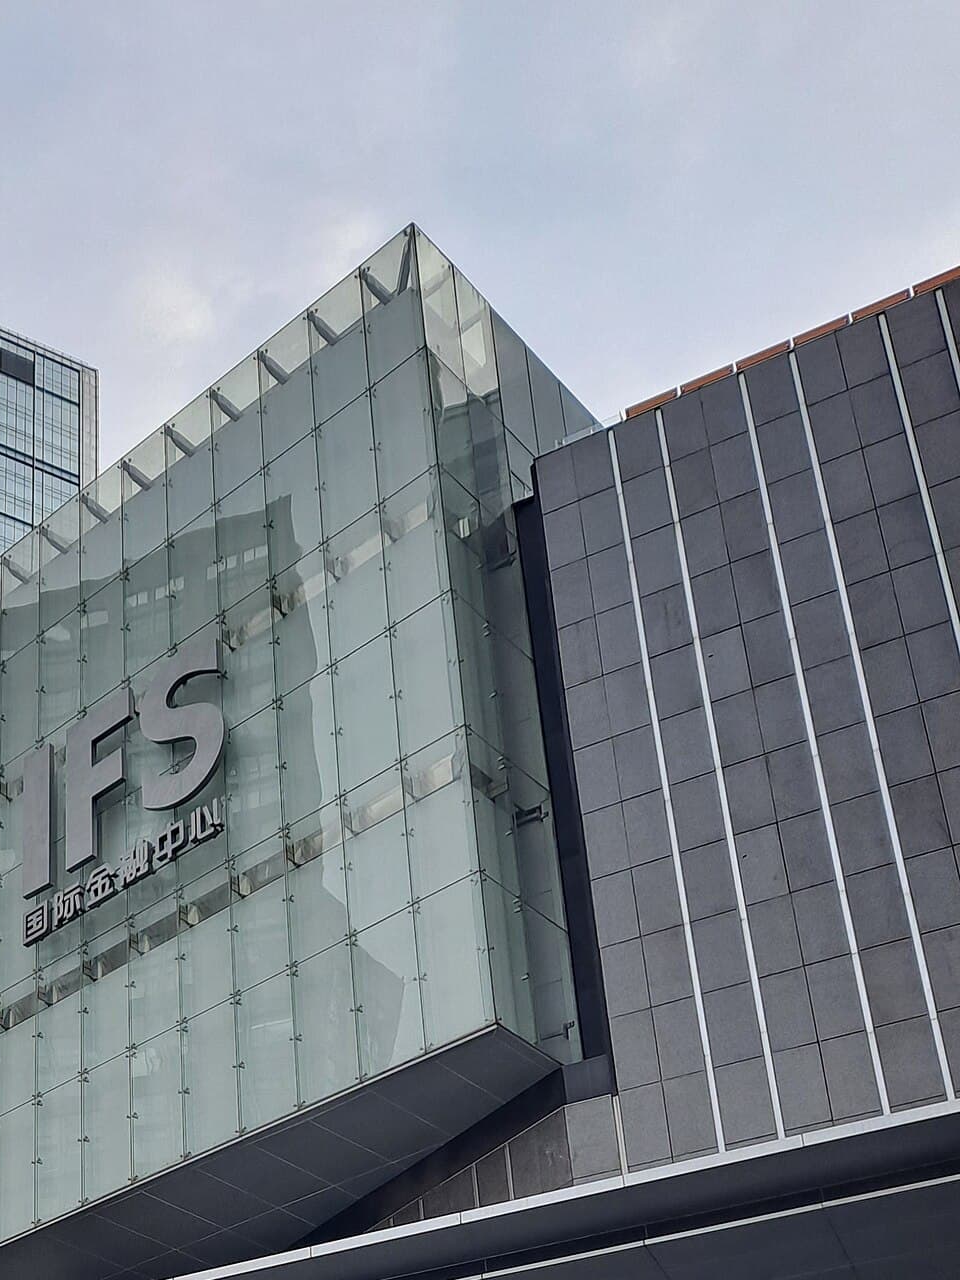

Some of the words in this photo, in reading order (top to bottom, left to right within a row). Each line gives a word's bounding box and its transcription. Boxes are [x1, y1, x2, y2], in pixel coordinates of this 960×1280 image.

[23, 622, 226, 898] IFS
[23, 797, 225, 947] 国际金融中心
